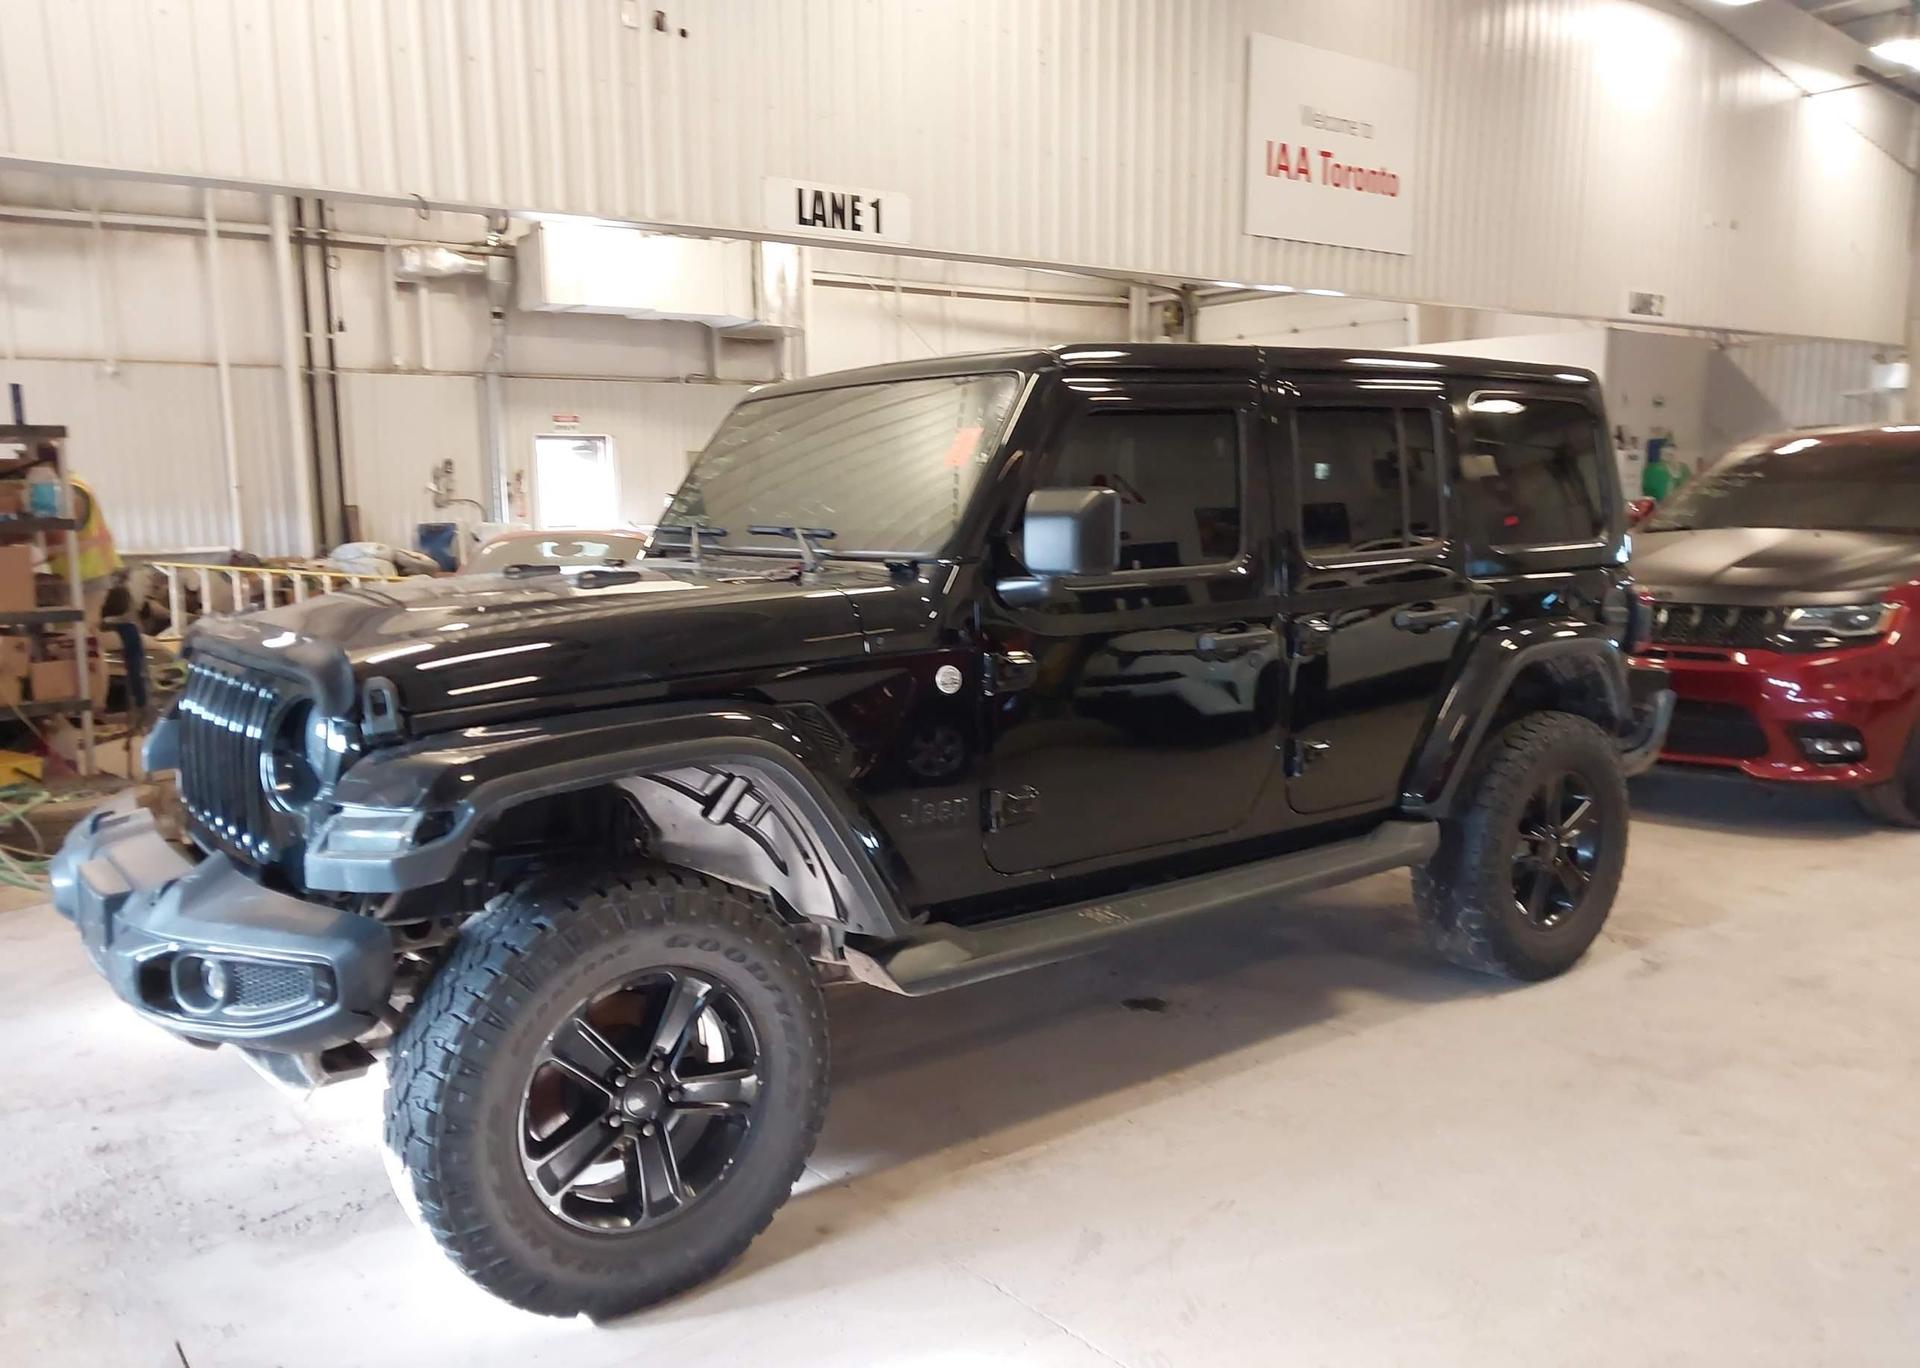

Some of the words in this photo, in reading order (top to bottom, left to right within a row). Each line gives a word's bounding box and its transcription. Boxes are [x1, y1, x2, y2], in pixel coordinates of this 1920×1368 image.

[1266, 140, 1312, 183] IAA
[1319, 150, 1400, 197] Toronto
[797, 187, 861, 231] LANE
[869, 198, 881, 233] 1
